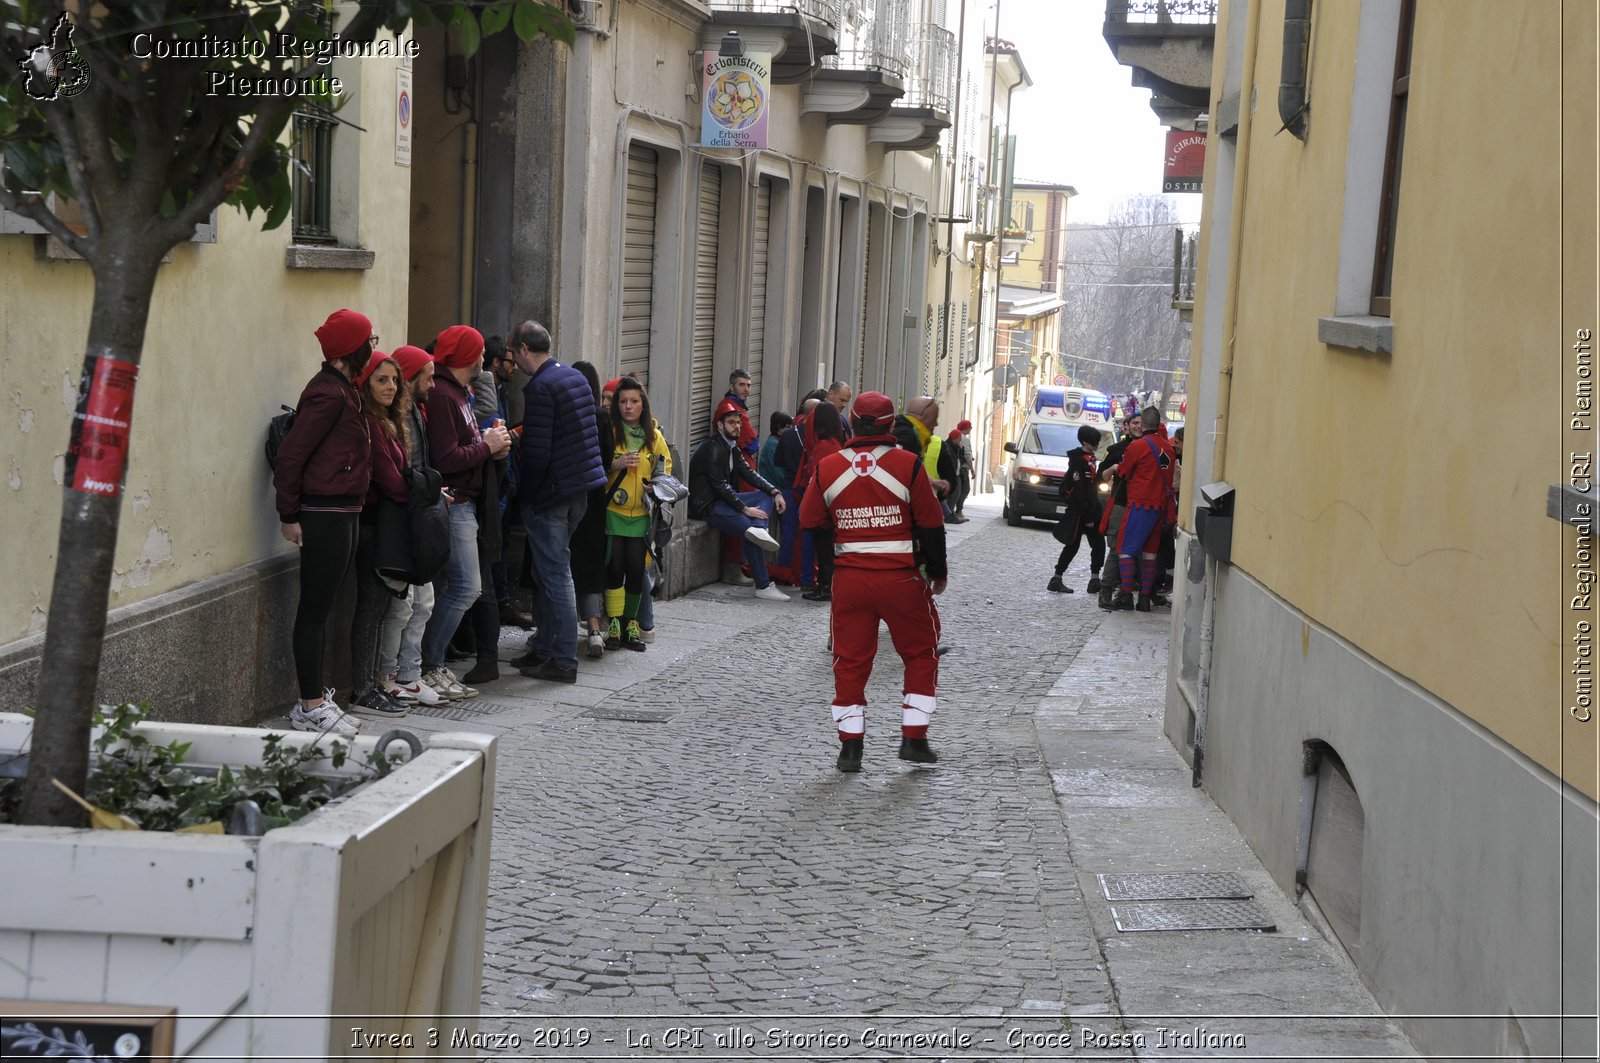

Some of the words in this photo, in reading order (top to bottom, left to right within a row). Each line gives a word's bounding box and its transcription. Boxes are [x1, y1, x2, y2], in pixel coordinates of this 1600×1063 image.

[706, 56, 768, 79] Erboristeria
[718, 130, 750, 139] Erbario
[710, 138, 731, 147] della
[734, 139, 758, 148] Serra
[1165, 182, 1204, 191] OSTE
[836, 508, 852, 519] CROCE
[852, 506, 873, 519] ROSSA
[873, 504, 901, 517] ITALIANA
[838, 518, 870, 529] SOCCORSI
[870, 515, 903, 527] SPECIALI
